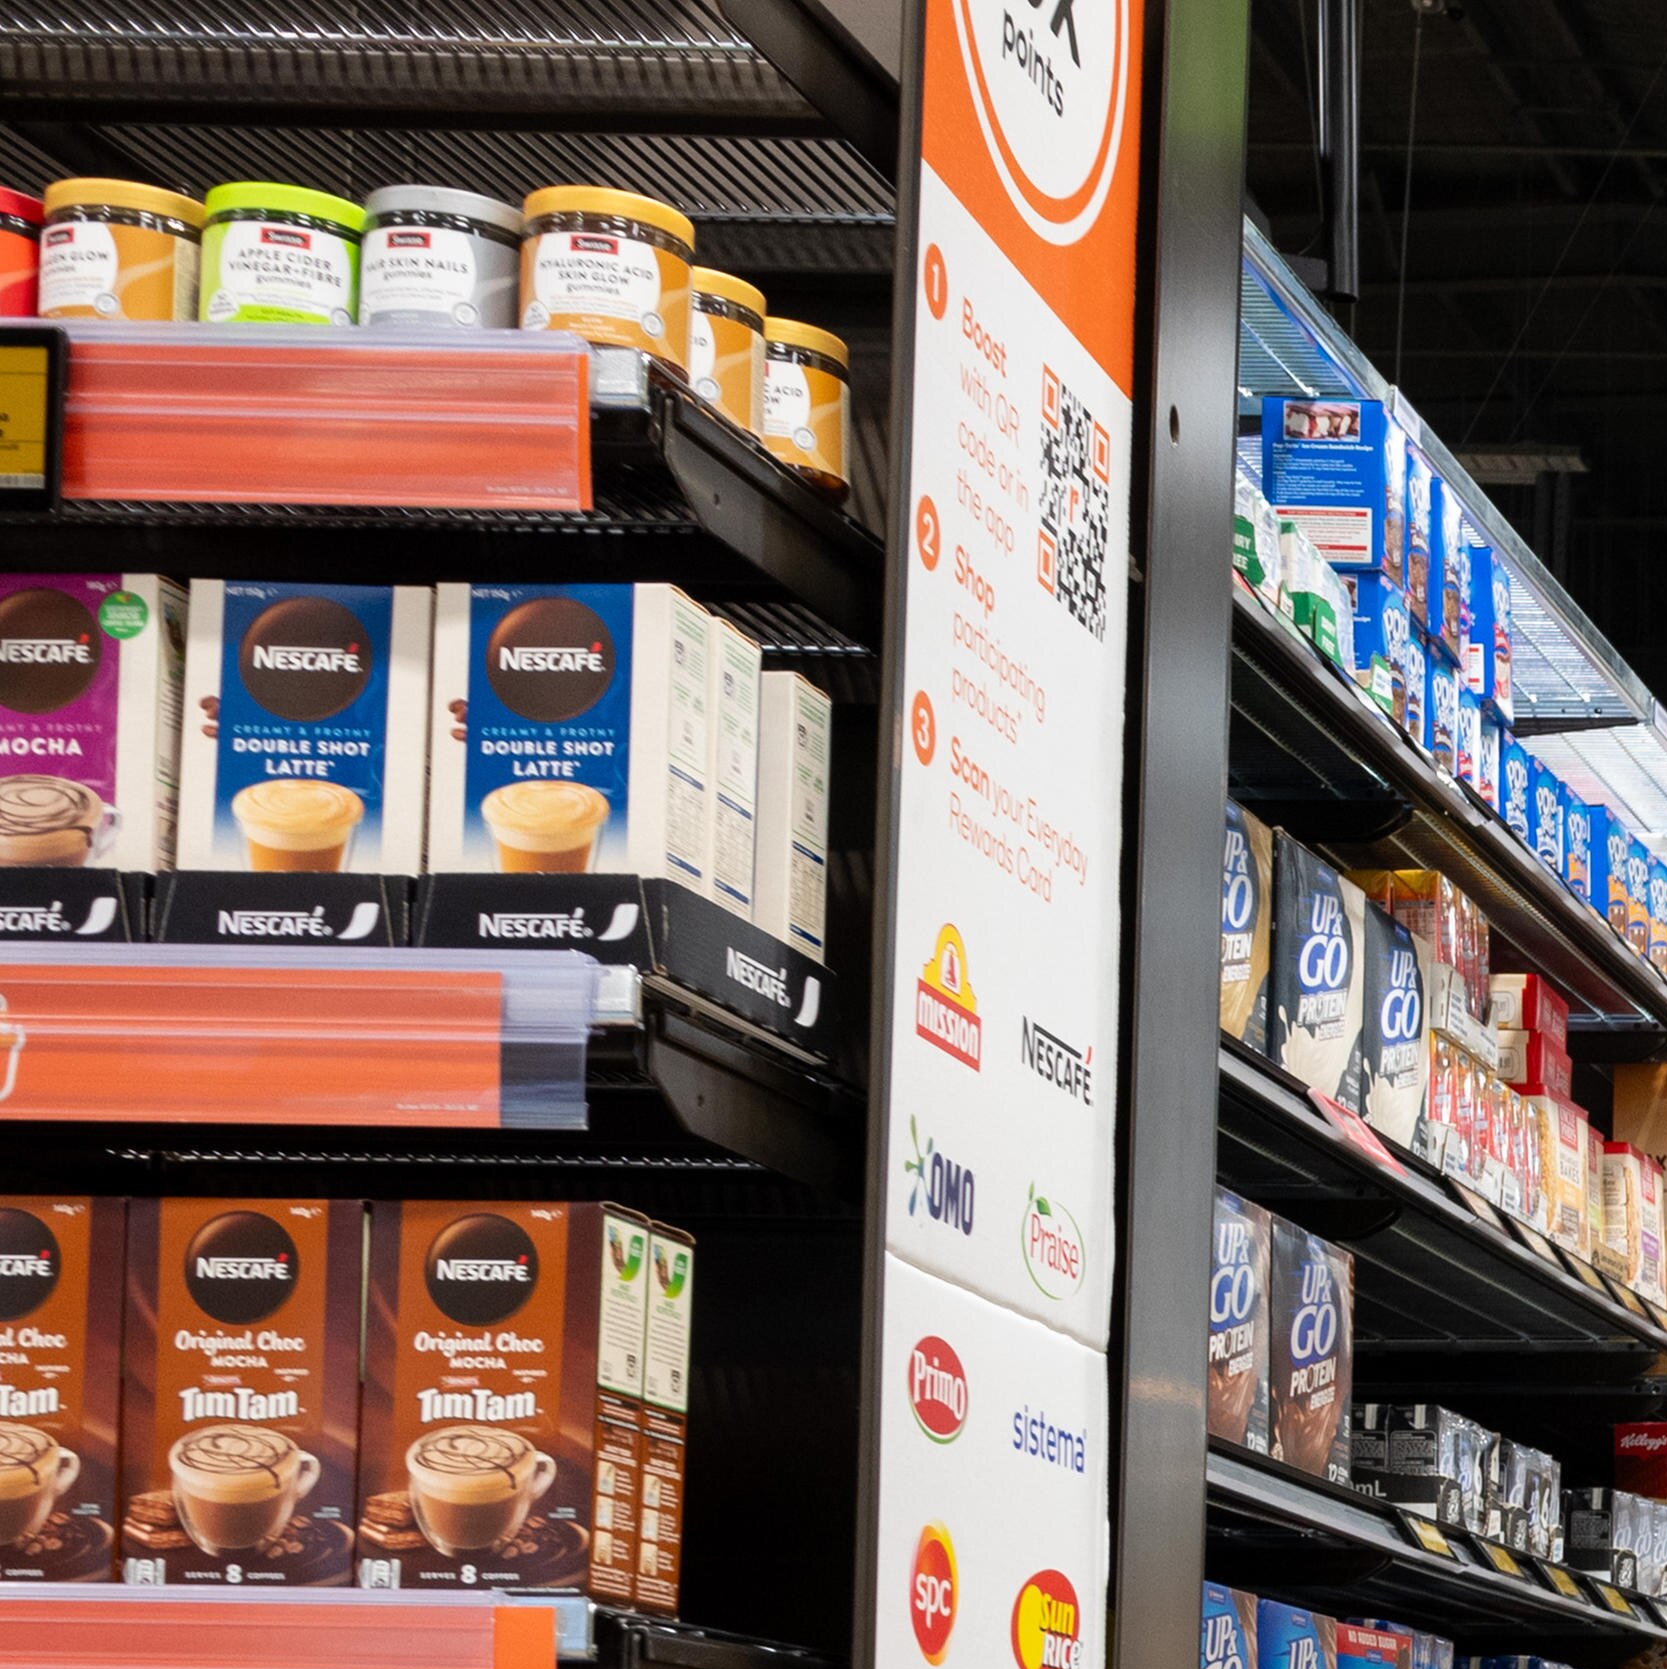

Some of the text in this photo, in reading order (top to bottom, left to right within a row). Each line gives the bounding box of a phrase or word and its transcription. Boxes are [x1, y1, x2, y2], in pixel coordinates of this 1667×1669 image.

[1002, 9, 1064, 117] points
[238, 248, 333, 270] APPLE CIDER
[389, 257, 469, 275] SKIN NAILS
[623, 264, 654, 282] ACID
[962, 296, 1007, 378] Boost
[960, 362, 1020, 448] with QR
[958, 420, 1029, 513] code or in
[922, 511, 935, 556] 2
[956, 467, 1015, 558] the app
[954, 543, 995, 620] Shop
[953, 611, 1046, 724] participating
[232, 737, 371, 758] DOUBLE SHOT
[481, 740, 615, 757] DOUBLE SHOT
[918, 707, 930, 750] 3
[950, 735, 1088, 887] Scan your Everyday
[950, 790, 1053, 903] Rewards Card
[1299, 936, 1349, 988] GO
[1299, 990, 1347, 1027] PROTEIN
[929, 1151, 975, 1236] OMO
[1031, 1213, 1079, 1280] Praise
[211, 1355, 268, 1369] MOCHA
[914, 1349, 964, 1421] Primo
[1013, 1404, 1085, 1473] sistema
[420, 1564, 519, 1585] SERVES 8 COFFEES
